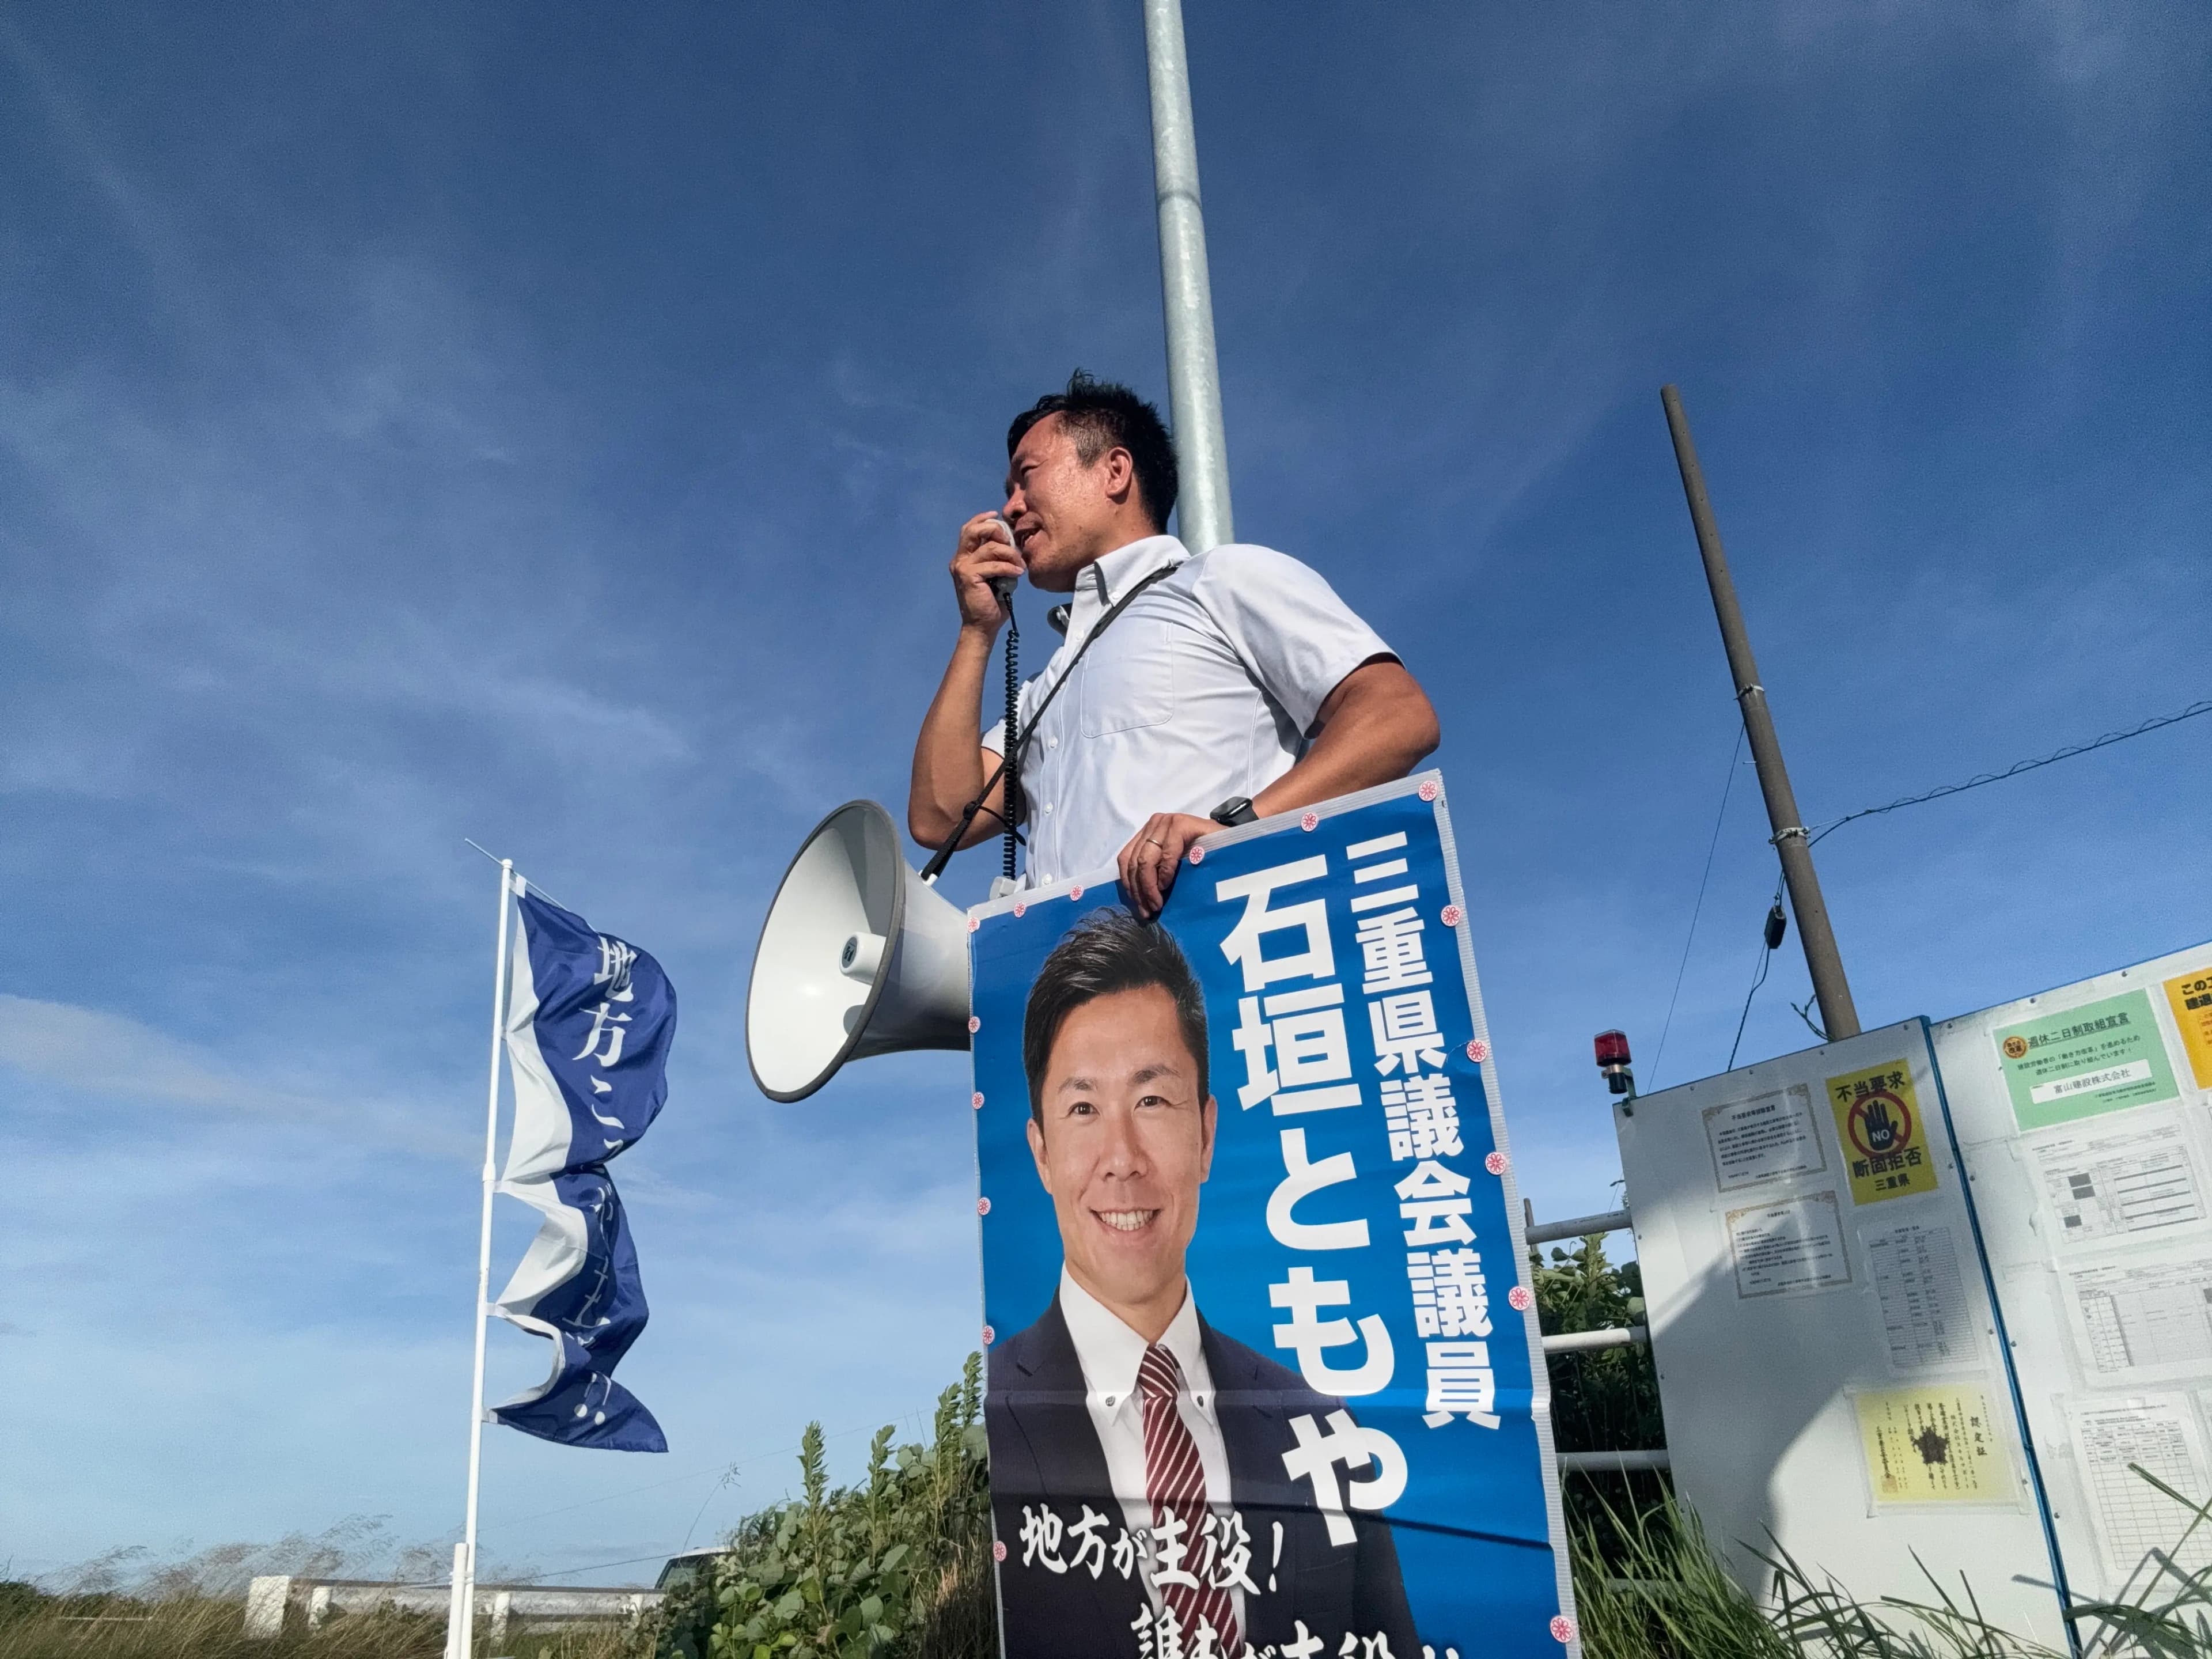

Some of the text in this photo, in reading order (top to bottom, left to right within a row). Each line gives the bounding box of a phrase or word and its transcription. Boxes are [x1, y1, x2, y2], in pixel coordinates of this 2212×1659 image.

[2027, 1012, 2130, 1048] 週休二日制取組宣言
[1835, 1071, 1906, 1103] 不当要求
[2053, 1068, 2131, 1094] 富山建設株式会社
[1346, 831, 1501, 1429] 三重県議会議員
[1872, 1129, 1890, 1142] NO
[1852, 1146, 1922, 1178] 断固拒否
[1874, 1173, 1910, 1191] 三重県
[1215, 854, 1407, 1547] 石垣ともや
[1018, 1503, 1283, 1594] 地方が主役!
